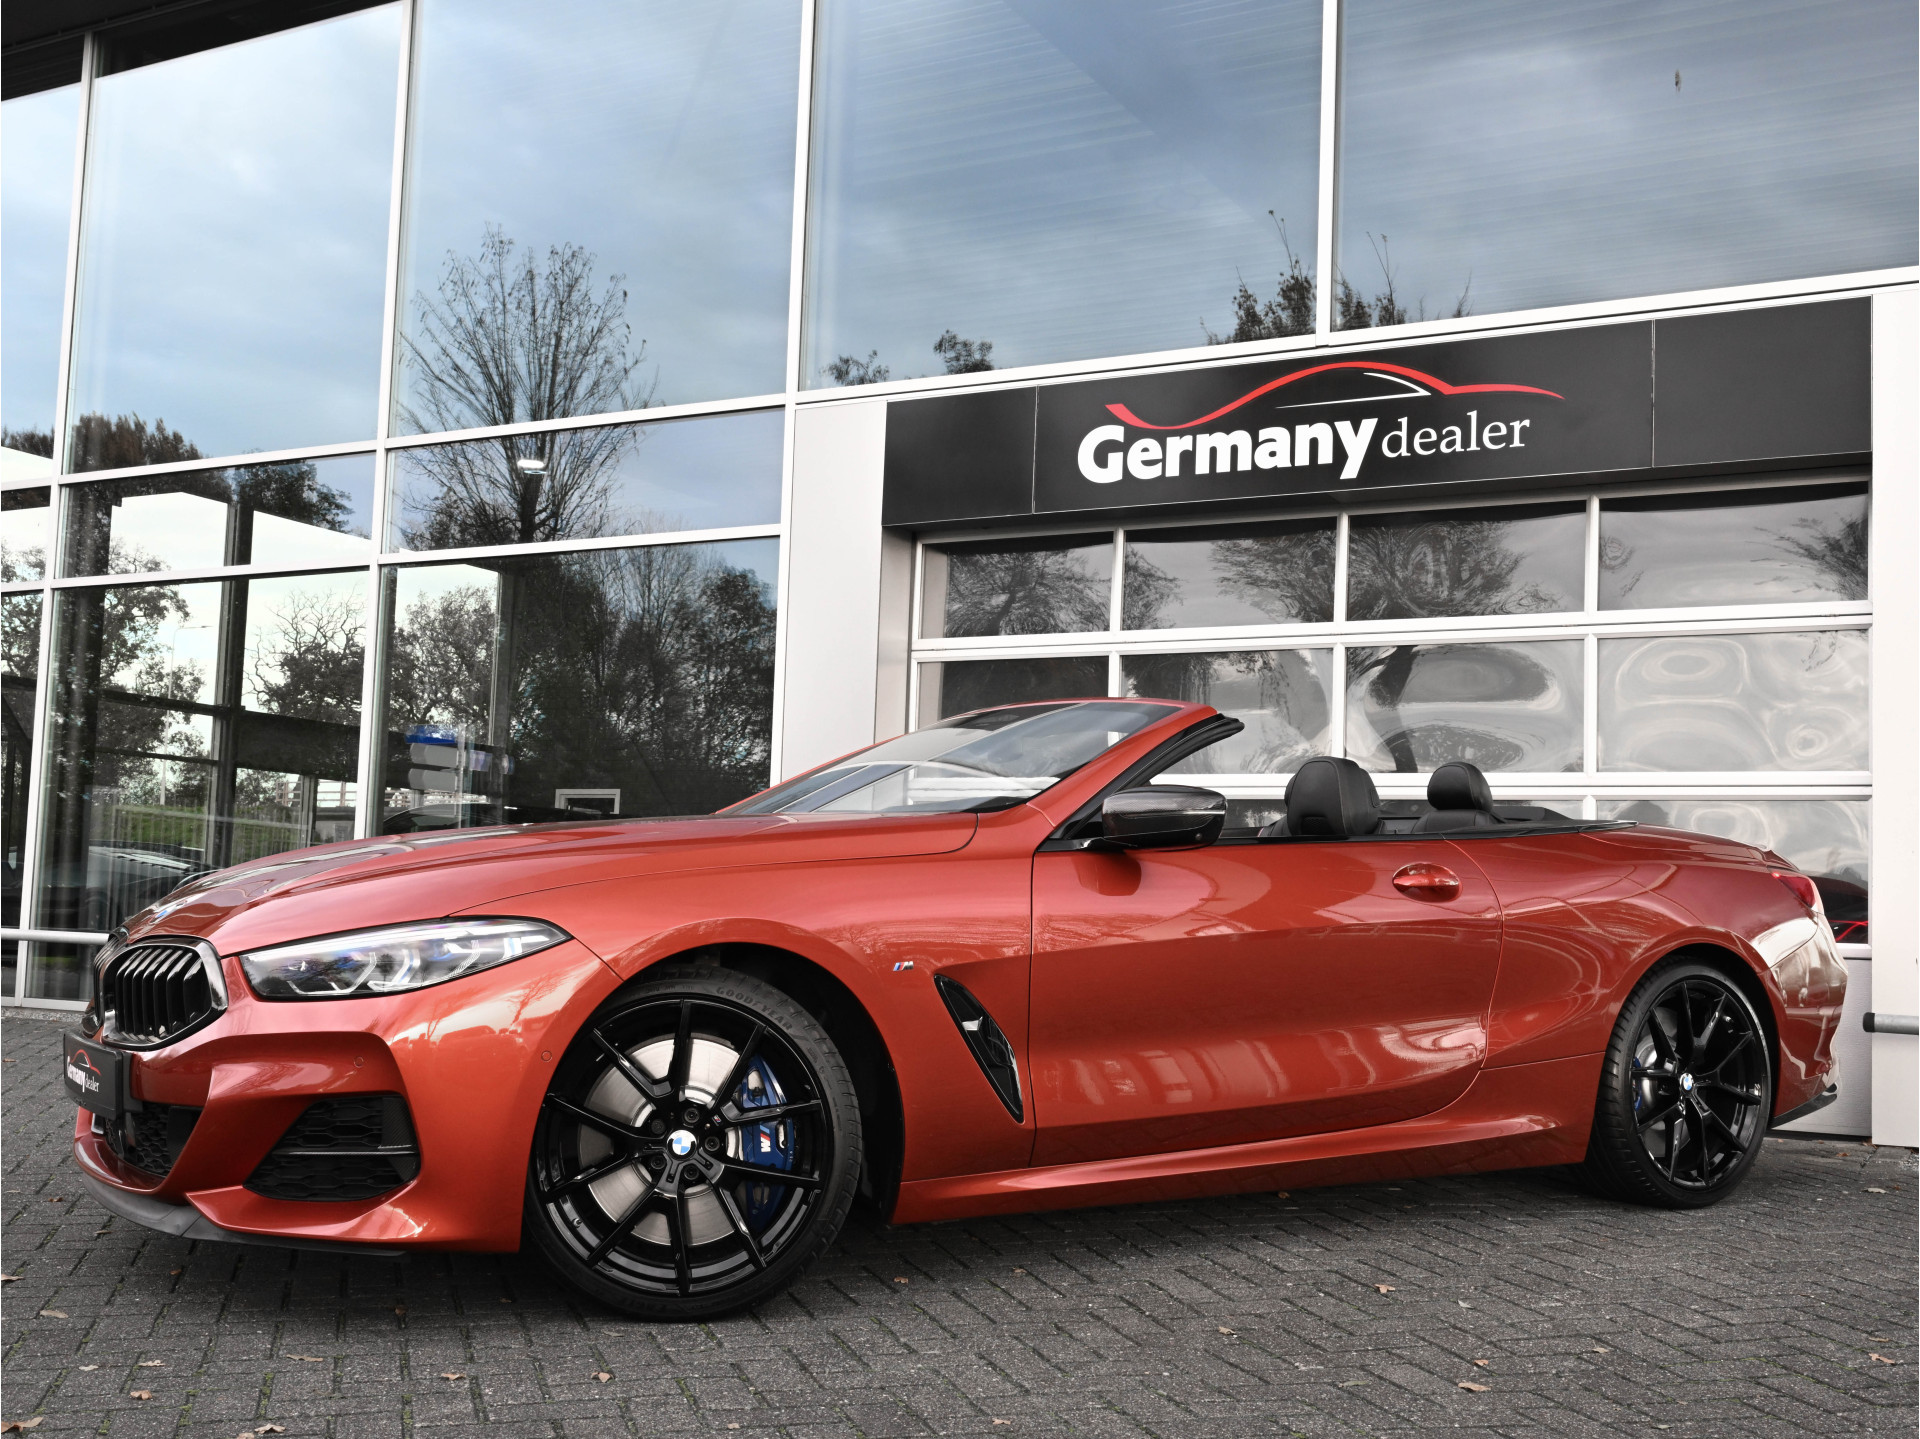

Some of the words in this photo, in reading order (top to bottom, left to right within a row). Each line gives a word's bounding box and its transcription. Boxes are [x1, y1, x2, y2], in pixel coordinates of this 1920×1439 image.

[1077, 417, 1379, 484] Germany
[1381, 410, 1531, 458] dealer
[715, 986, 793, 1031] GOODYEAR
